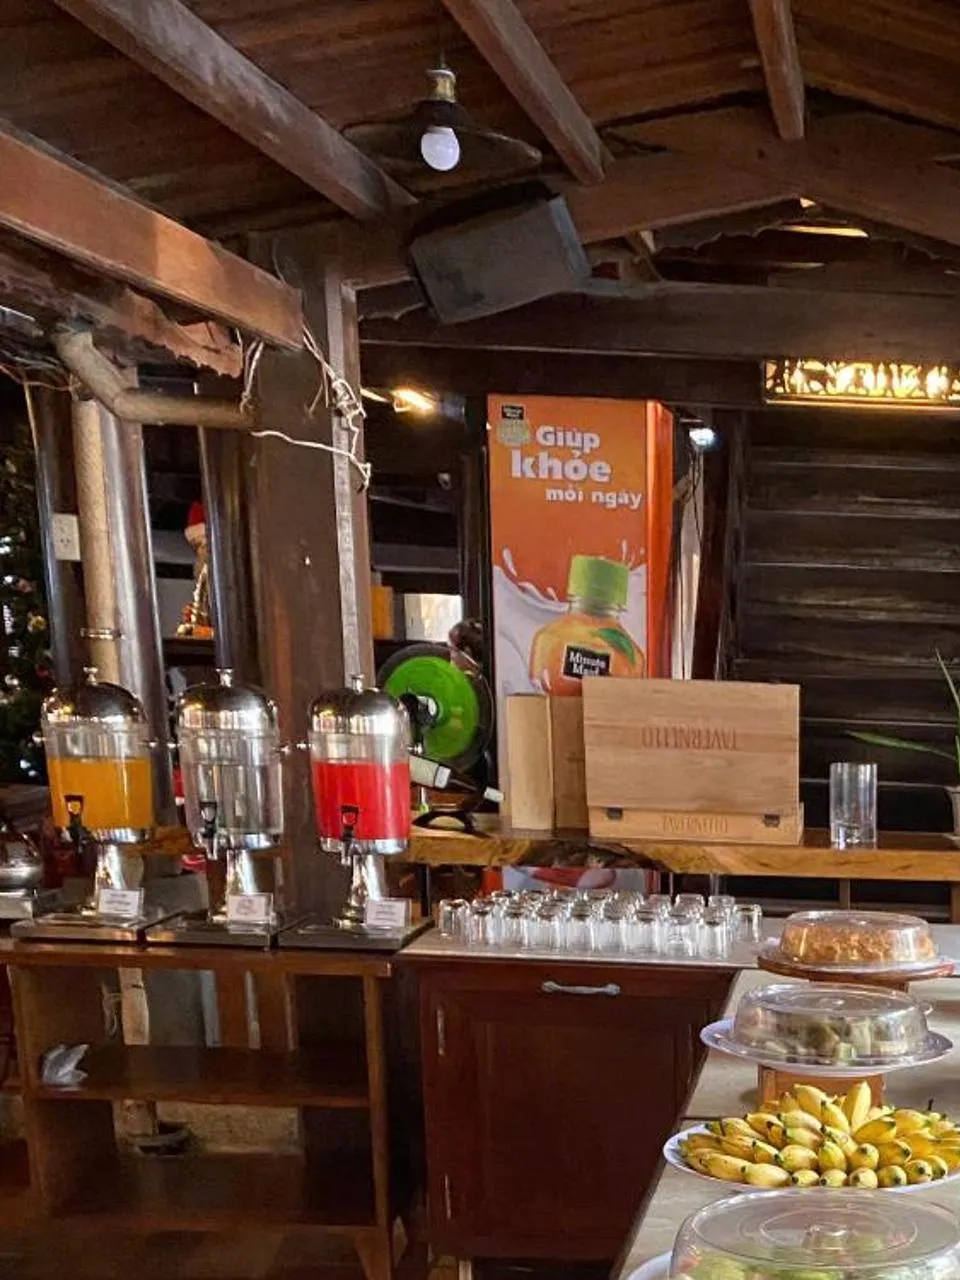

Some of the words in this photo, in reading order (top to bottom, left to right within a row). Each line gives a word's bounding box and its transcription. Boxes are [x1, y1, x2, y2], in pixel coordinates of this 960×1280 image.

[536, 425, 600, 454] Giúp
[511, 449, 611, 482] khỏe
[570, 651, 606, 669] Minute
